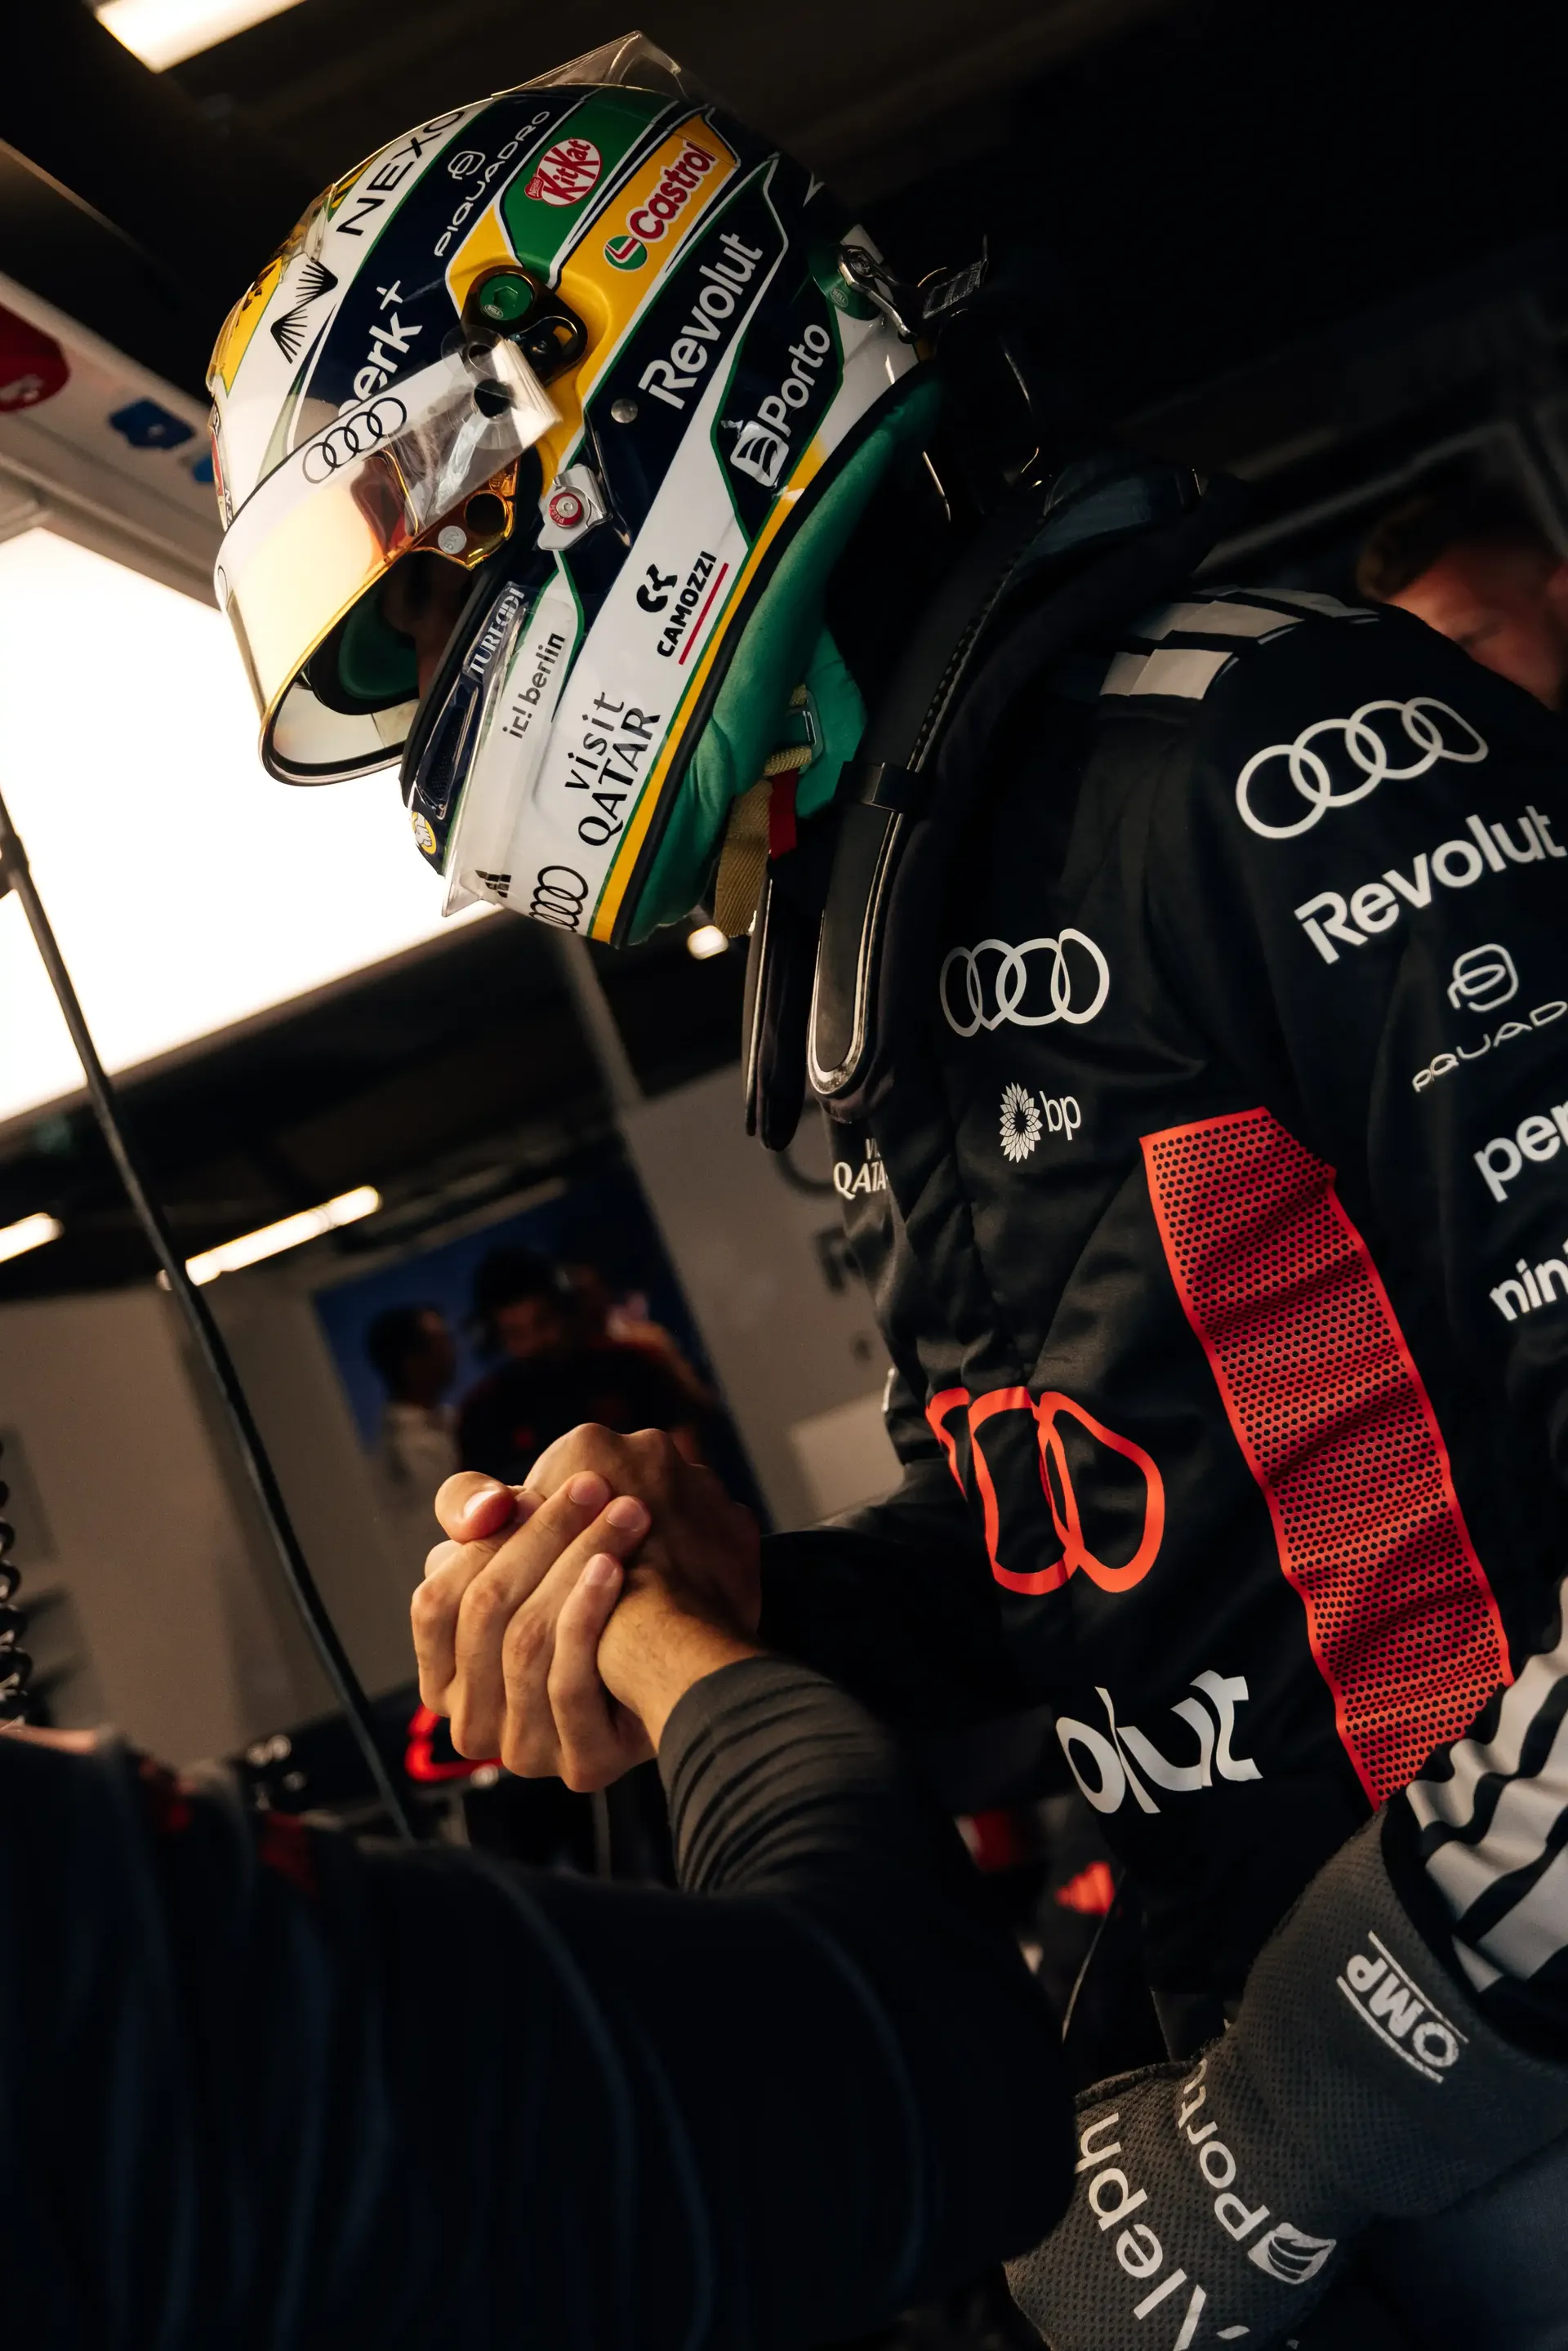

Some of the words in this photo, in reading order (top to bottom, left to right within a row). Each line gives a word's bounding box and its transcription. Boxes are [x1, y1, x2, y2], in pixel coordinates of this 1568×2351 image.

[336, 110, 465, 238] NEXO
[434, 110, 550, 256] PIQUADRO
[538, 140, 599, 202] KitKat
[630, 141, 716, 240] Castrol
[638, 234, 763, 409] Revolut
[756, 324, 830, 437] Porto
[656, 550, 718, 657] CAMOZZI
[518, 633, 565, 706] berlin
[565, 692, 624, 790] visit
[578, 707, 661, 846] QATAR
[1294, 805, 1568, 965] Revolut
[1412, 1001, 1568, 1093] PQUAD
[1039, 1090, 1081, 1141] bp
[833, 1160, 889, 1200] QATA
[1489, 1237, 1568, 1321] nin
[1347, 1954, 1459, 2068] OMP
